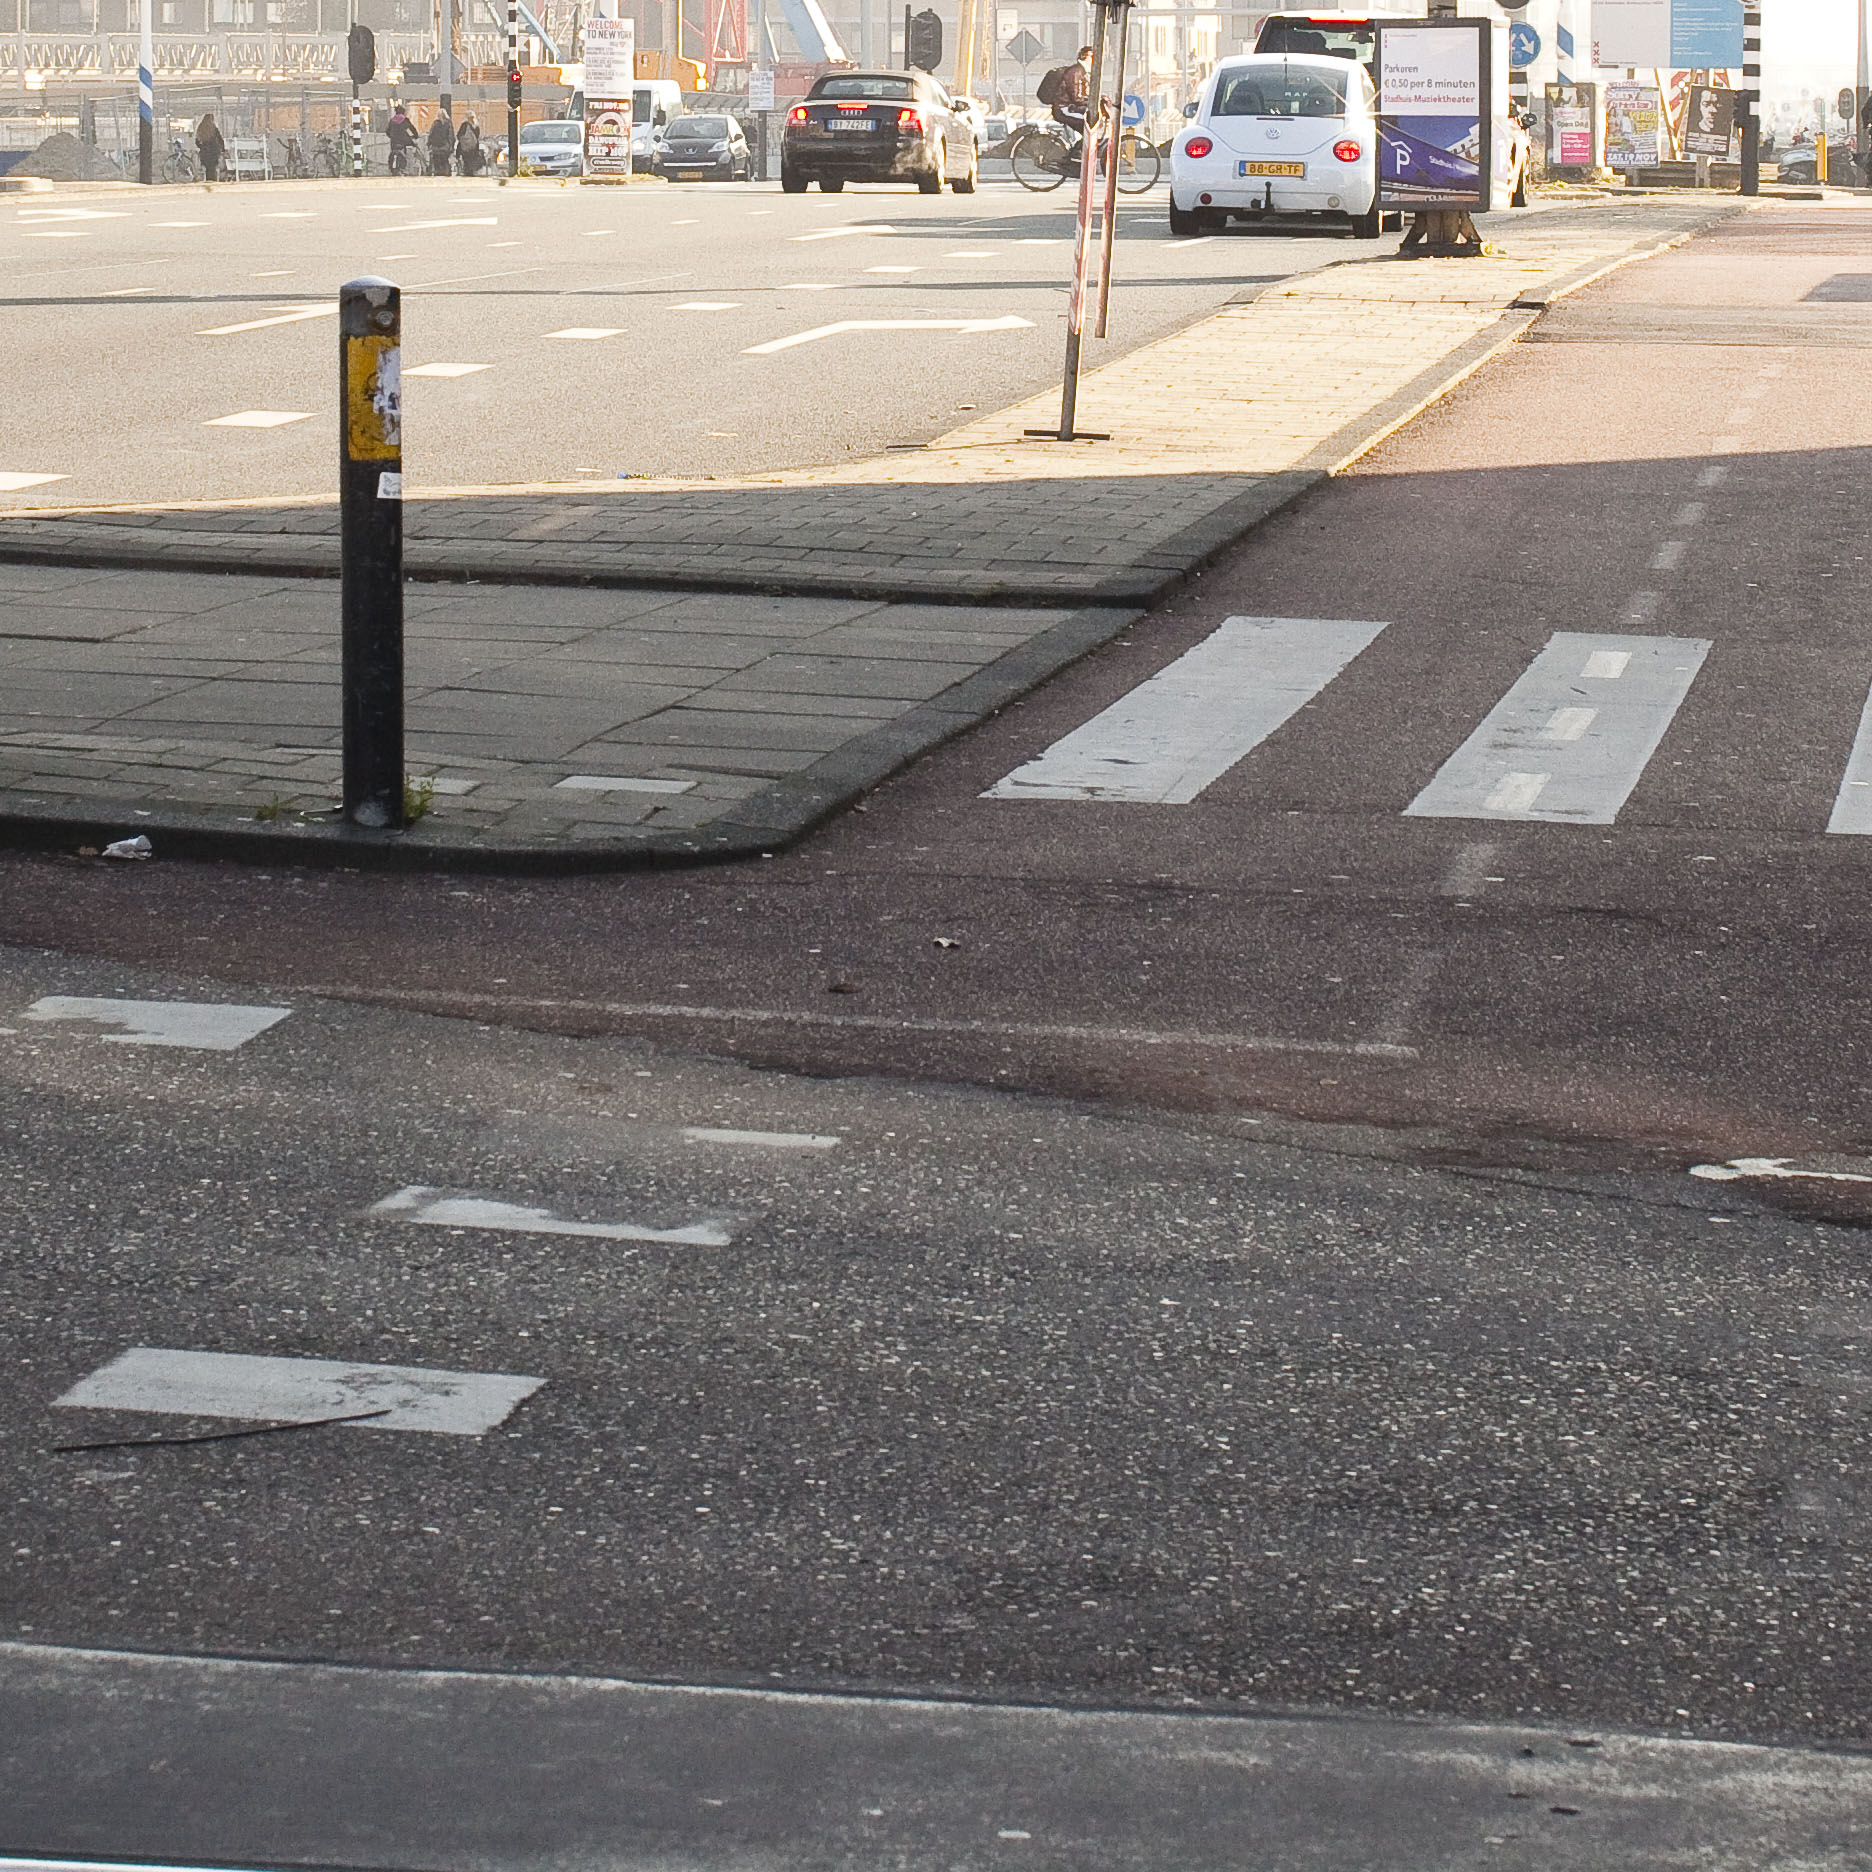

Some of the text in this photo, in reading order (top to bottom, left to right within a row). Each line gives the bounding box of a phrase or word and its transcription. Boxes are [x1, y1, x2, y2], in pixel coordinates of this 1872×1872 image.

[1384, 63, 1419, 73] Parkeren
[1410, 80, 1425, 90] per
[1434, 79, 1476, 88] minuten
